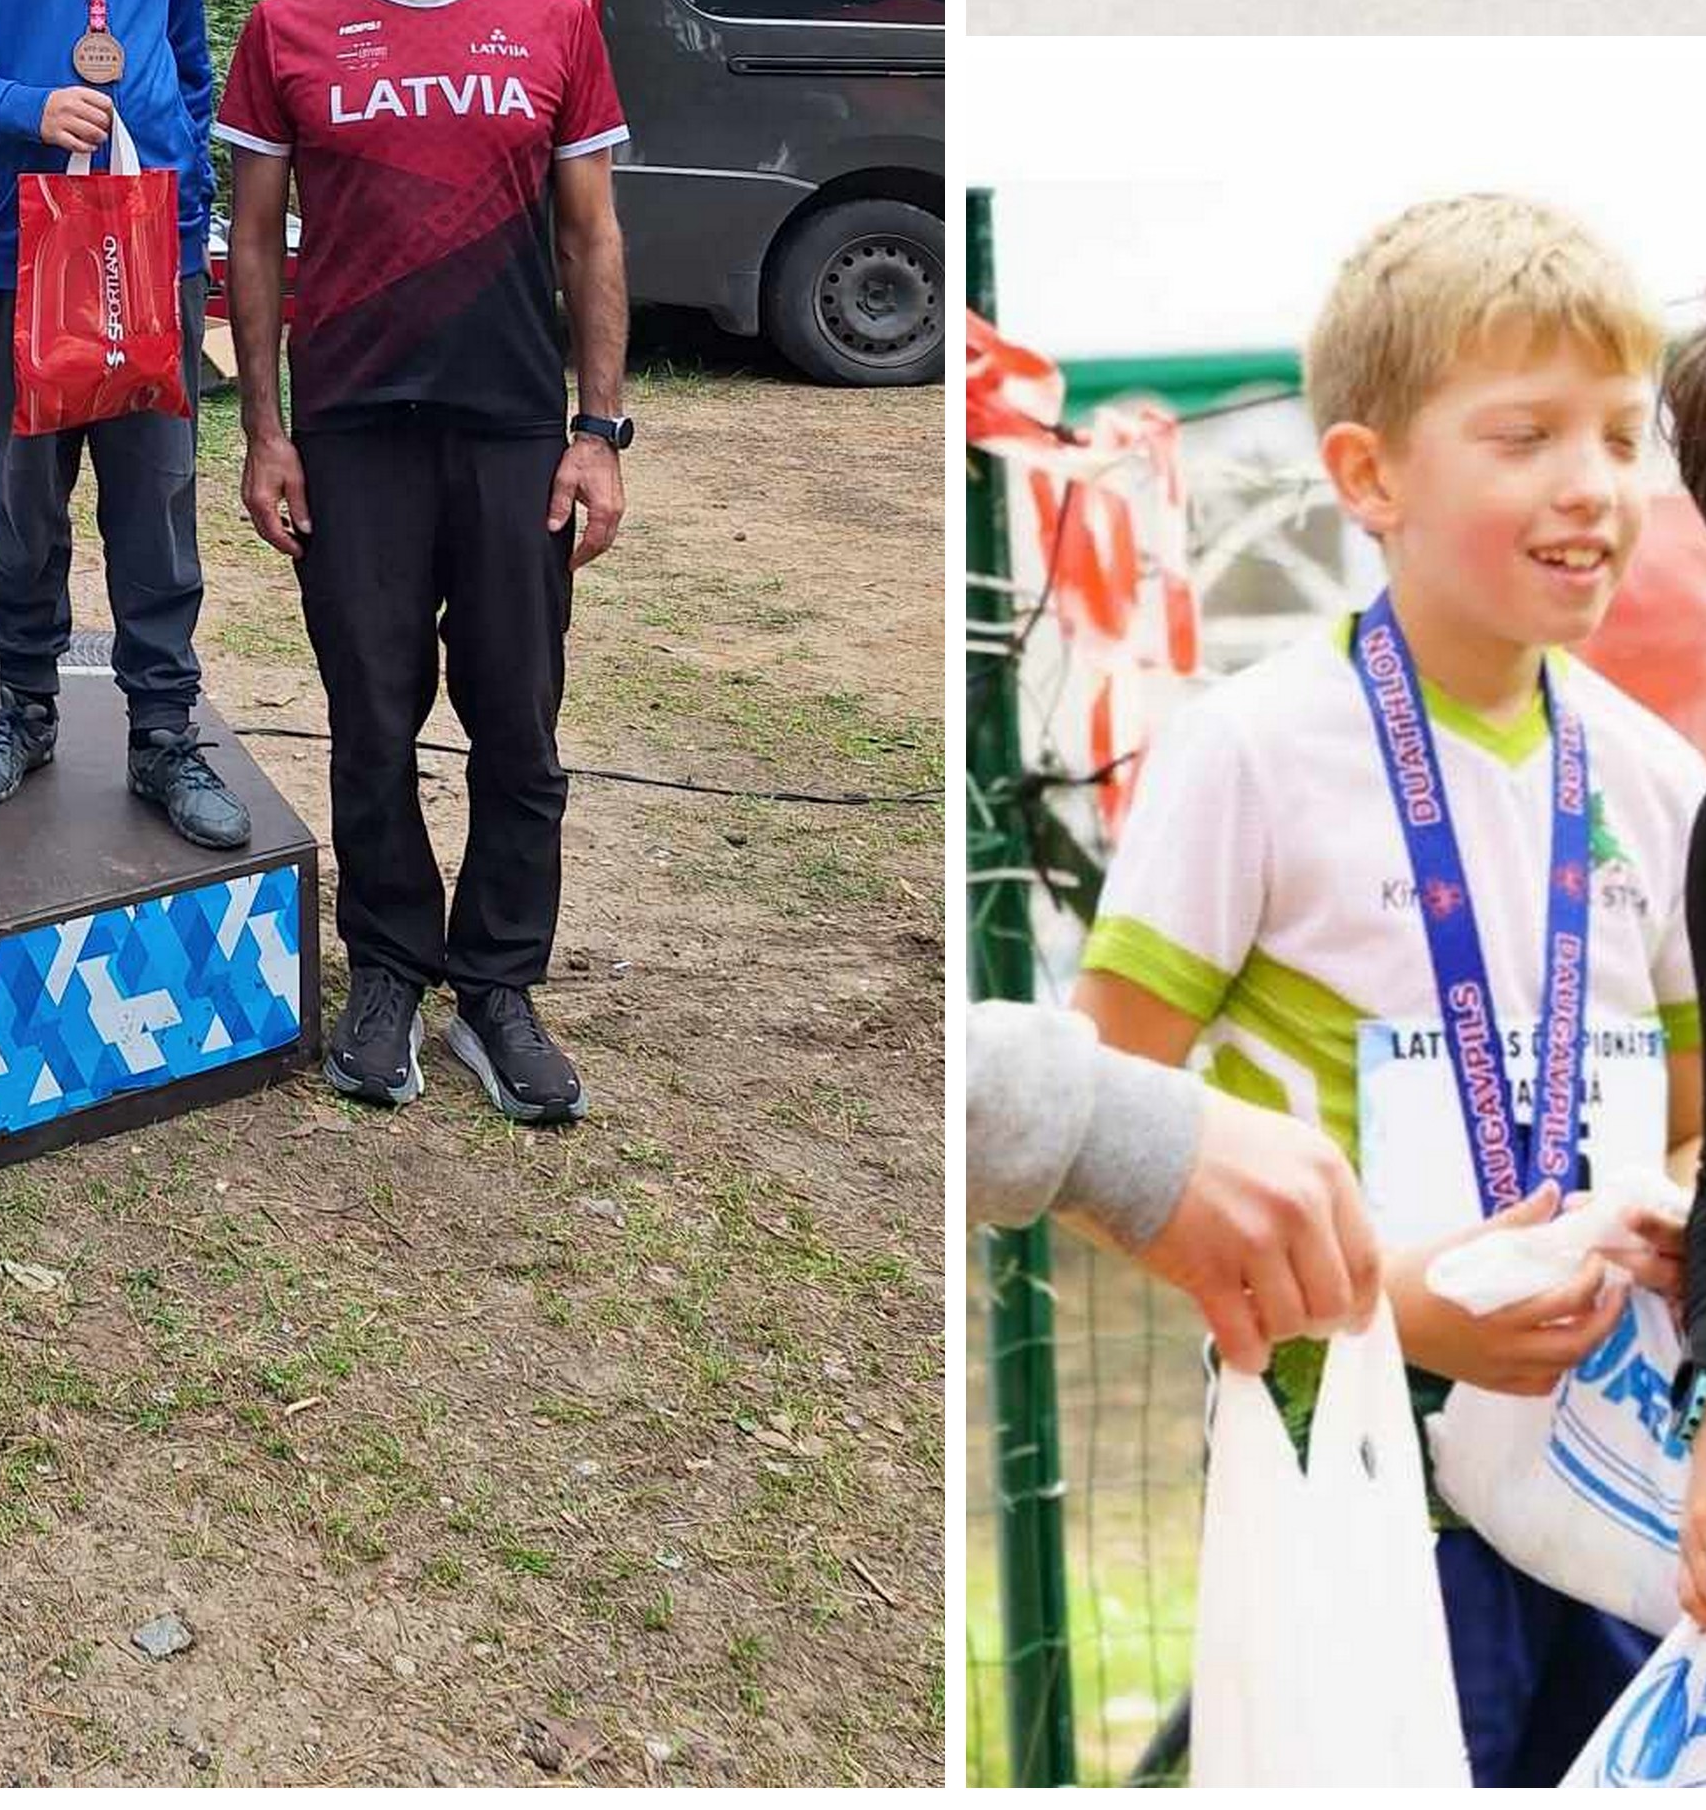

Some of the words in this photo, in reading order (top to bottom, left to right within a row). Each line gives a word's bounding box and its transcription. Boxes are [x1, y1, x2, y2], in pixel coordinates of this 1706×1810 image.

[330, 74, 536, 124] LATVIA
[470, 42, 531, 59] LATVIJA
[102, 235, 125, 341] SPORTLAND
[1362, 623, 1442, 828] DUATHLON
[1392, 1032, 1522, 1060] LATS
[1449, 981, 1524, 1212] AUGAVPILS
[1538, 931, 1581, 1177] DAUGAVPILS
